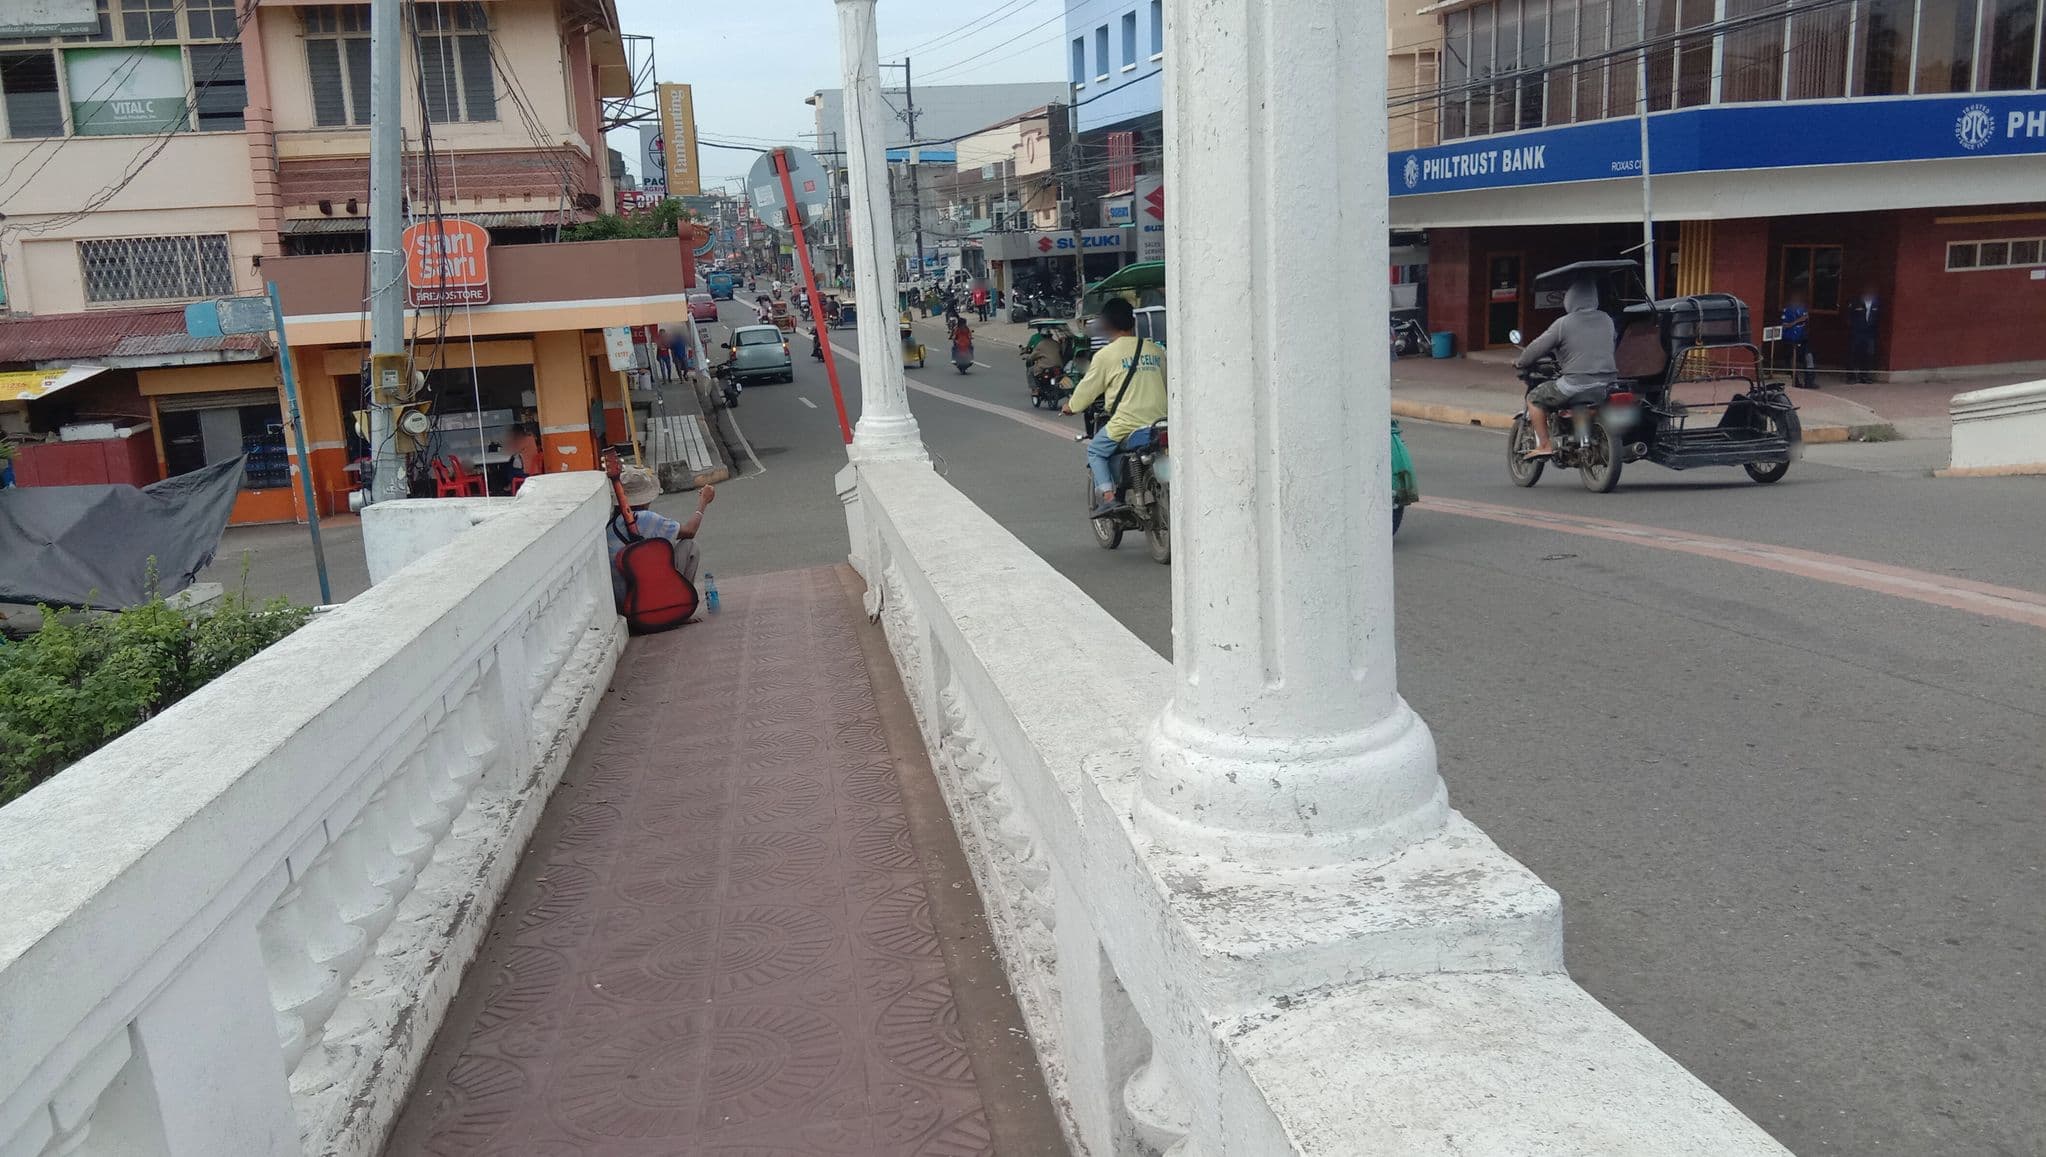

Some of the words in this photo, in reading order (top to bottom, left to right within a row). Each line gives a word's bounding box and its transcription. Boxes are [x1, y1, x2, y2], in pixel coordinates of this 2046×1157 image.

[111, 102, 145, 114] VITAL
[146, 101, 154, 113] C
[1423, 150, 1498, 181] PHILTRUST
[1502, 144, 1546, 173] BANK
[1611, 160, 1634, 171] ROXAS
